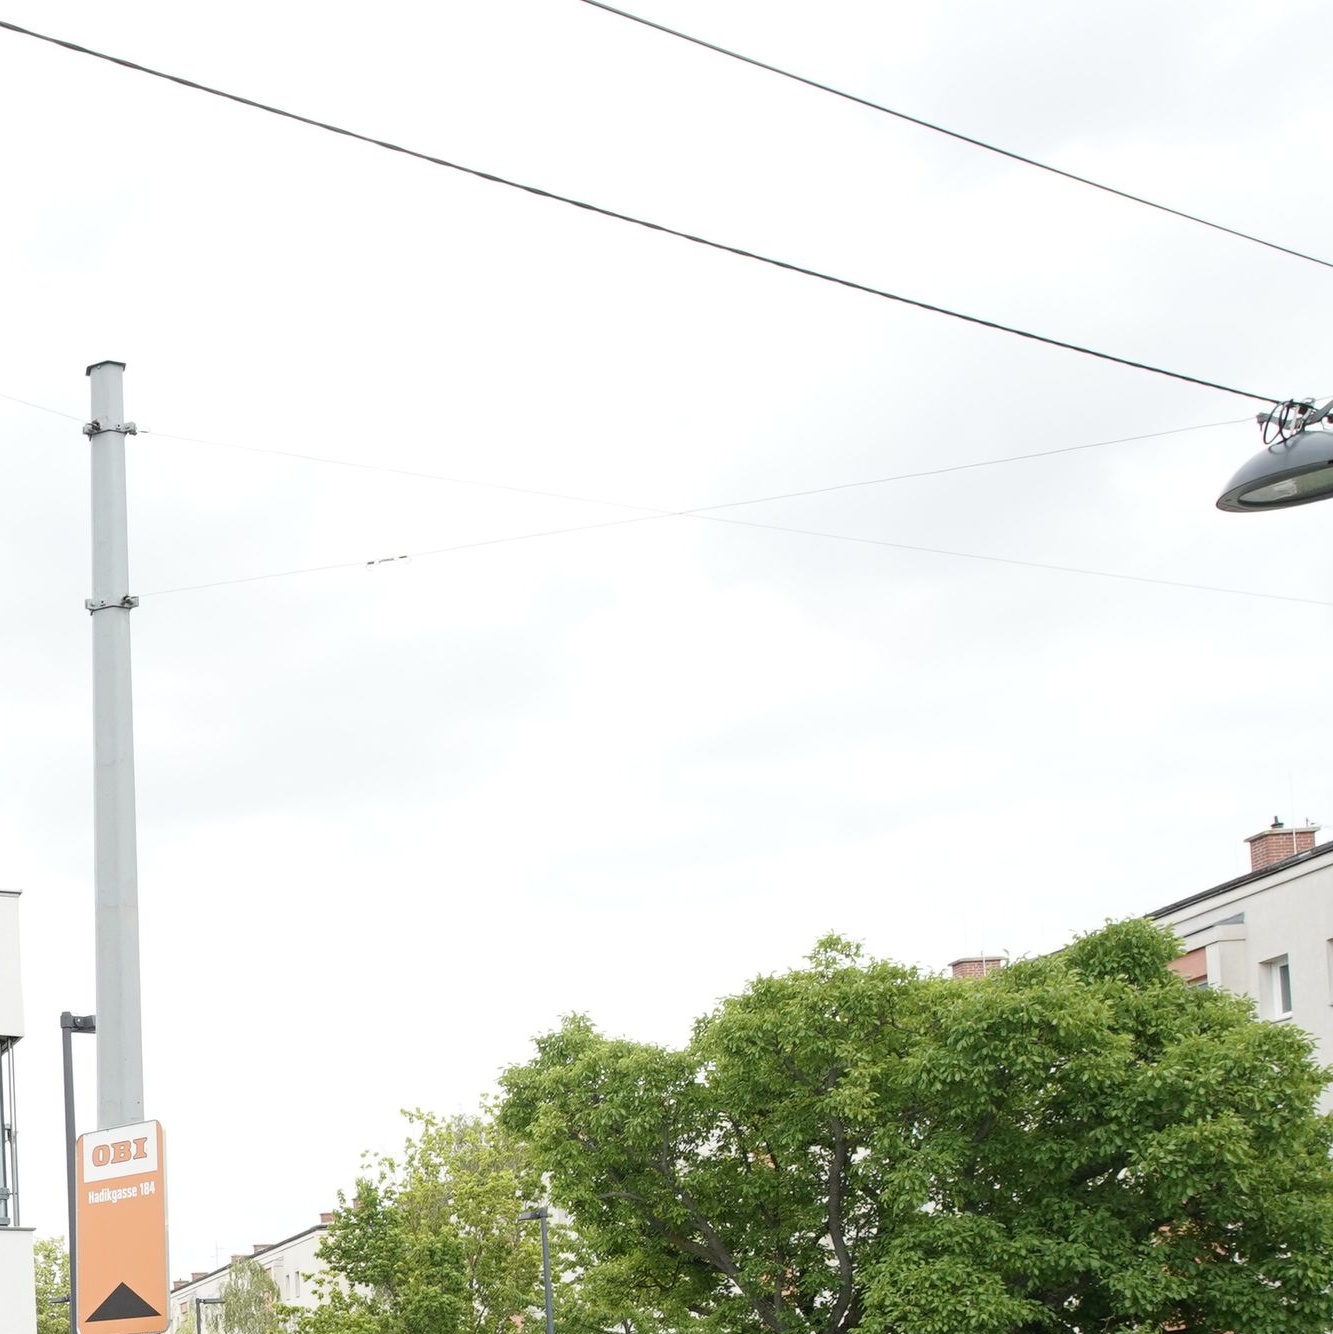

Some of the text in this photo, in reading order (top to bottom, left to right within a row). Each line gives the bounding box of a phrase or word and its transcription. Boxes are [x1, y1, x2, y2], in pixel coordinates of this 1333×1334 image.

[92, 1137, 148, 1167] OBI
[88, 1181, 156, 1204] Hadikgasse 184
